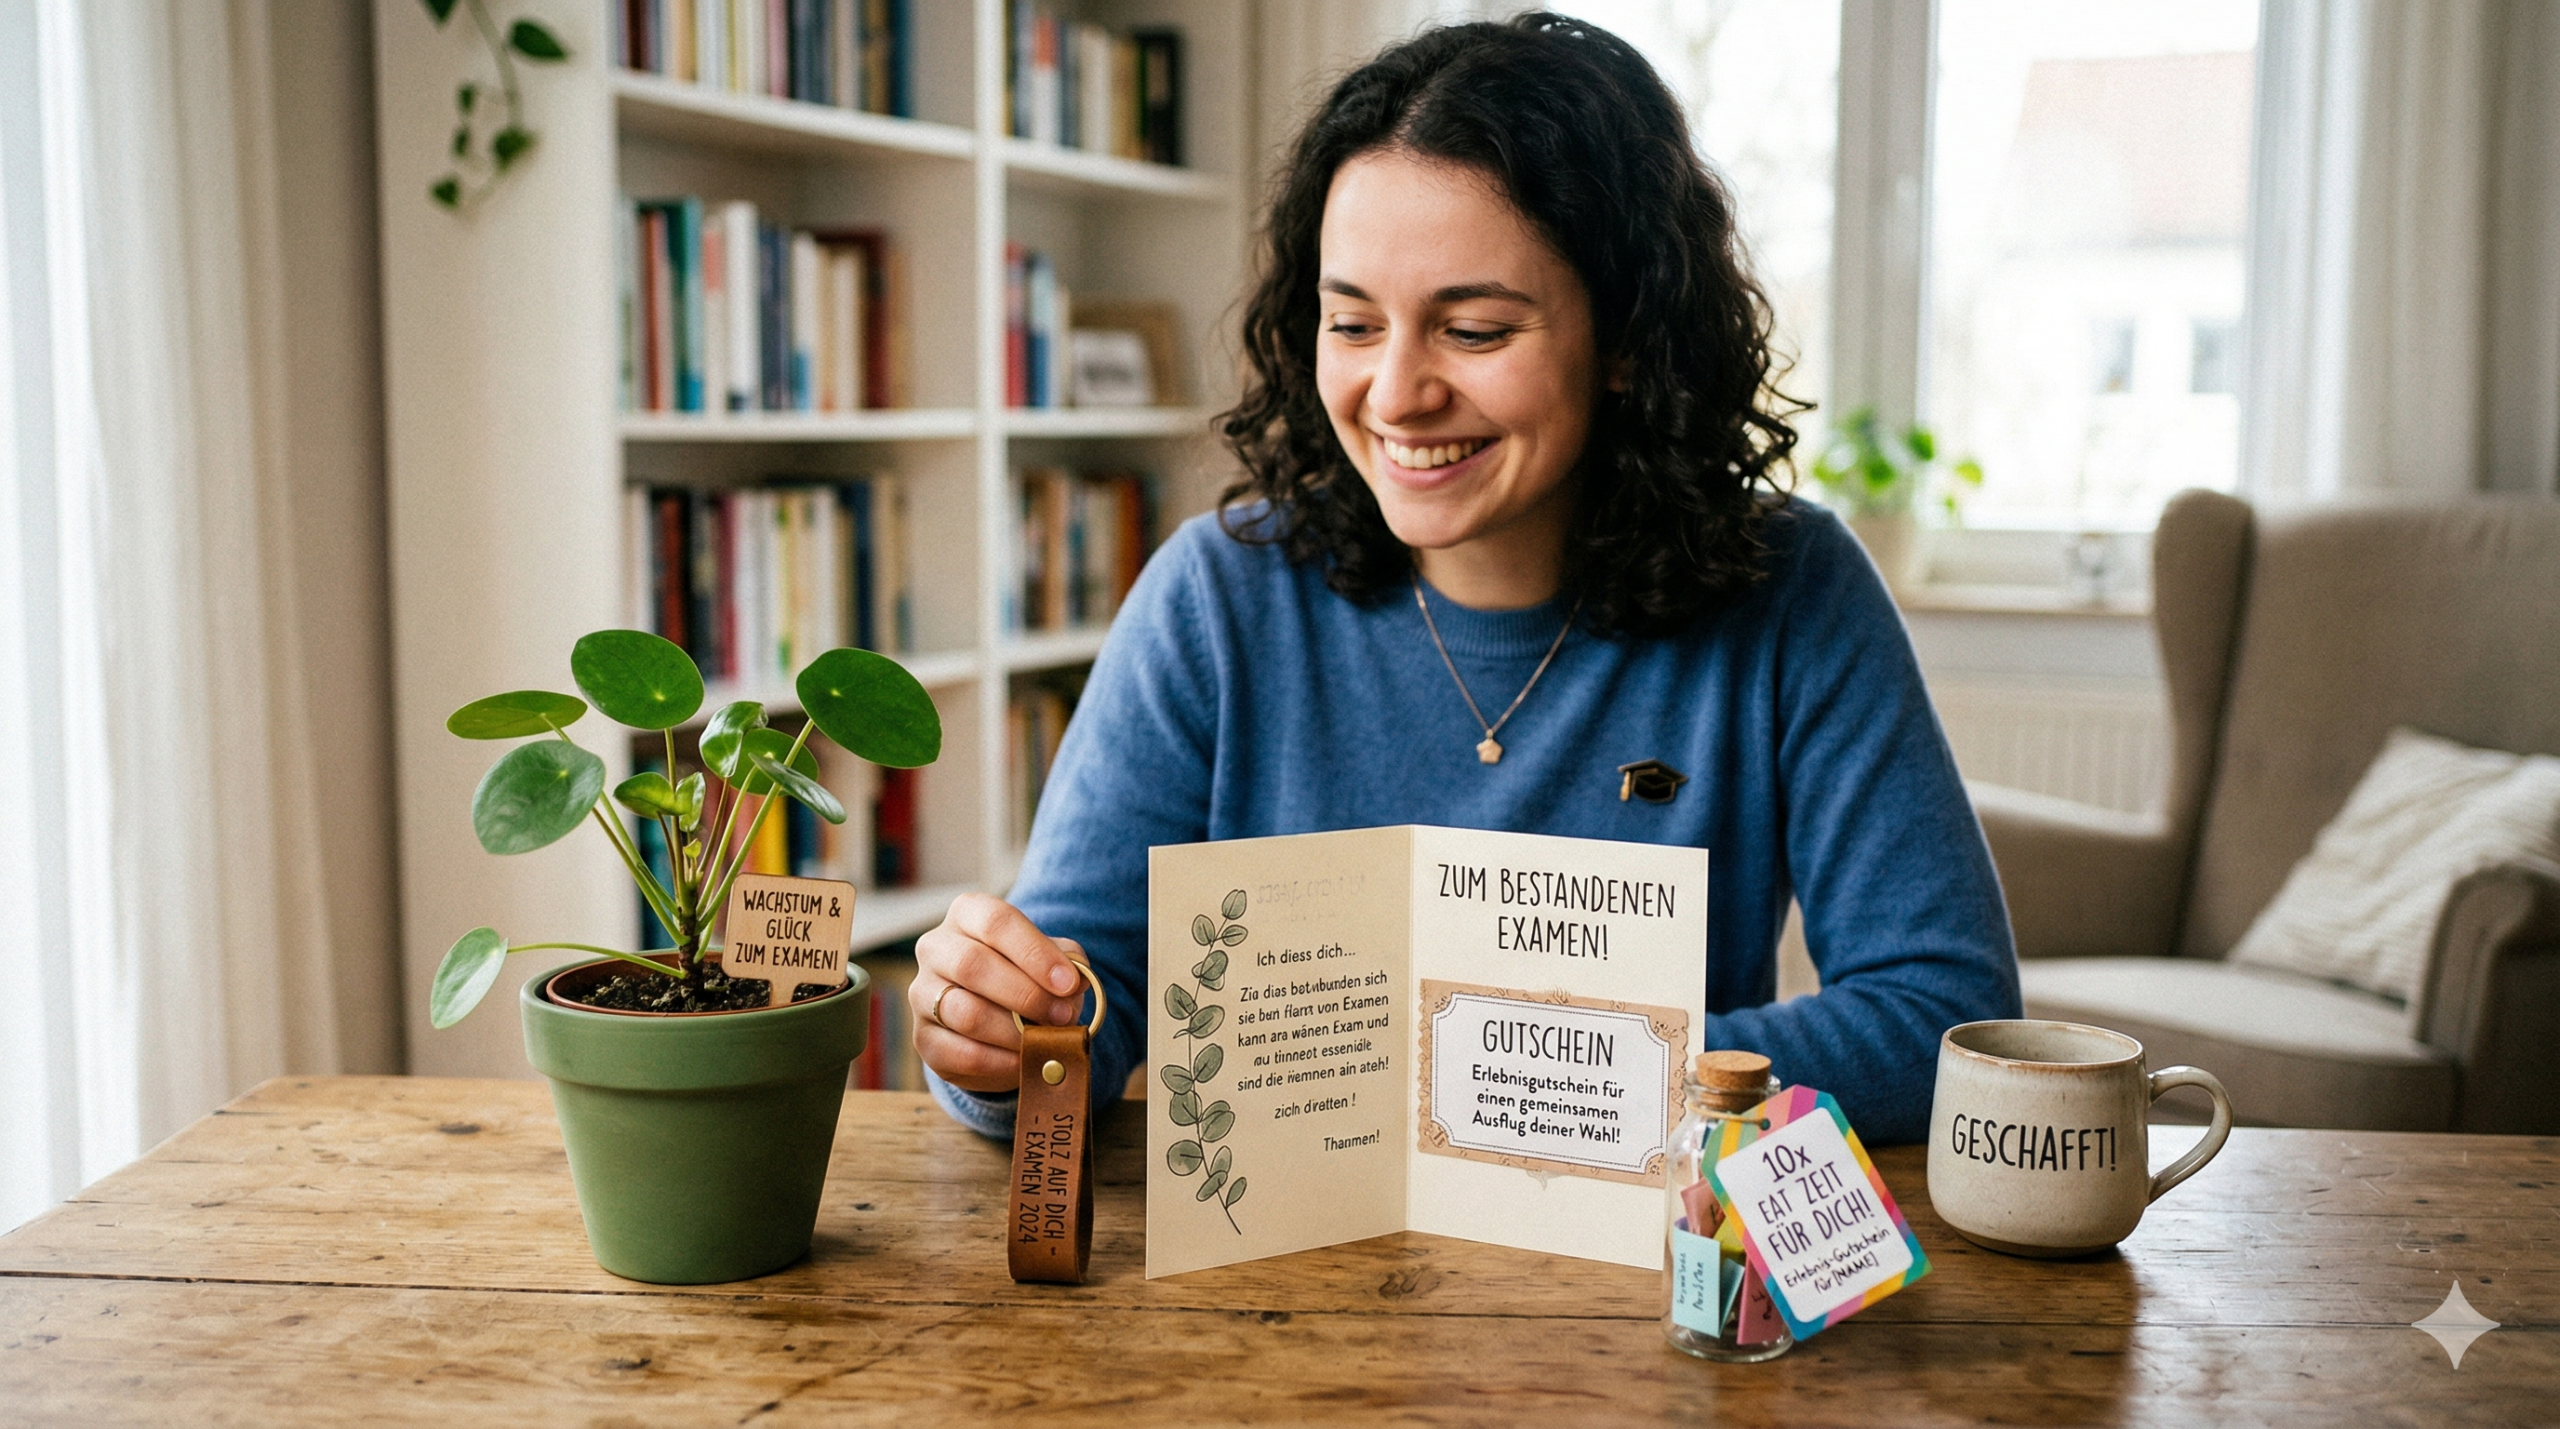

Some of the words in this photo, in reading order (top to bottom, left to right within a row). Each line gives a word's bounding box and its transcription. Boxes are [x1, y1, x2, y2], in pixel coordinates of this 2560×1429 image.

[743, 890, 822, 916] WACHSTUM
[829, 897, 841, 918] &
[1438, 863, 1486, 902] ZUM
[1500, 867, 1675, 918] BESTANDENEN
[766, 916, 812, 942] GLÜCK
[1498, 916, 1608, 960] EXAMEN!
[735, 942, 765, 965] ZUM
[1257, 950, 1275, 966] Ich
[1280, 949, 1312, 964] diess
[1317, 942, 1356, 959] dich...
[1365, 969, 1387, 986] sich
[1238, 1010, 1255, 1025] sie
[1317, 1002, 1339, 1014] von
[1343, 995, 1389, 1011] Examen
[1238, 1033, 1266, 1047] kann
[1270, 1031, 1288, 1043] ara
[1333, 1020, 1363, 1034] Exam
[1367, 1013, 1389, 1029] und
[1483, 1020, 1614, 1067] GUTSCHEIN
[1237, 1074, 1262, 1091] sind
[1265, 1072, 1283, 1087] die
[1360, 1056, 1389, 1074] ateh!
[1472, 1064, 1598, 1096] Erlebnisgutschein
[1602, 1080, 1625, 1098] für
[1477, 1089, 1515, 1107] einen
[1519, 1095, 1619, 1121] gemeinsamen
[1050, 1114, 1074, 1160] STOLZ
[1472, 1110, 1526, 1137] Ausflug
[1530, 1117, 1575, 1138] deiner
[1579, 1122, 1621, 1144] Wahl!
[1952, 1113, 2116, 1171] GESCHAFFT!
[1020, 1131, 1046, 1196] EXAMEN
[1762, 1144, 1812, 1183] 10x
[1047, 1166, 1069, 1197] AUF
[1758, 1188, 1793, 1225] EAT
[1795, 1161, 1844, 1206] ZEIT
[1018, 1202, 1040, 1244] 2024
[1043, 1203, 1067, 1239] DICH
[1767, 1221, 1812, 1261] FÜR
[1812, 1188, 1875, 1240] DICH!
[1784, 1226, 1890, 1288] Erlebnis-Gutschein
